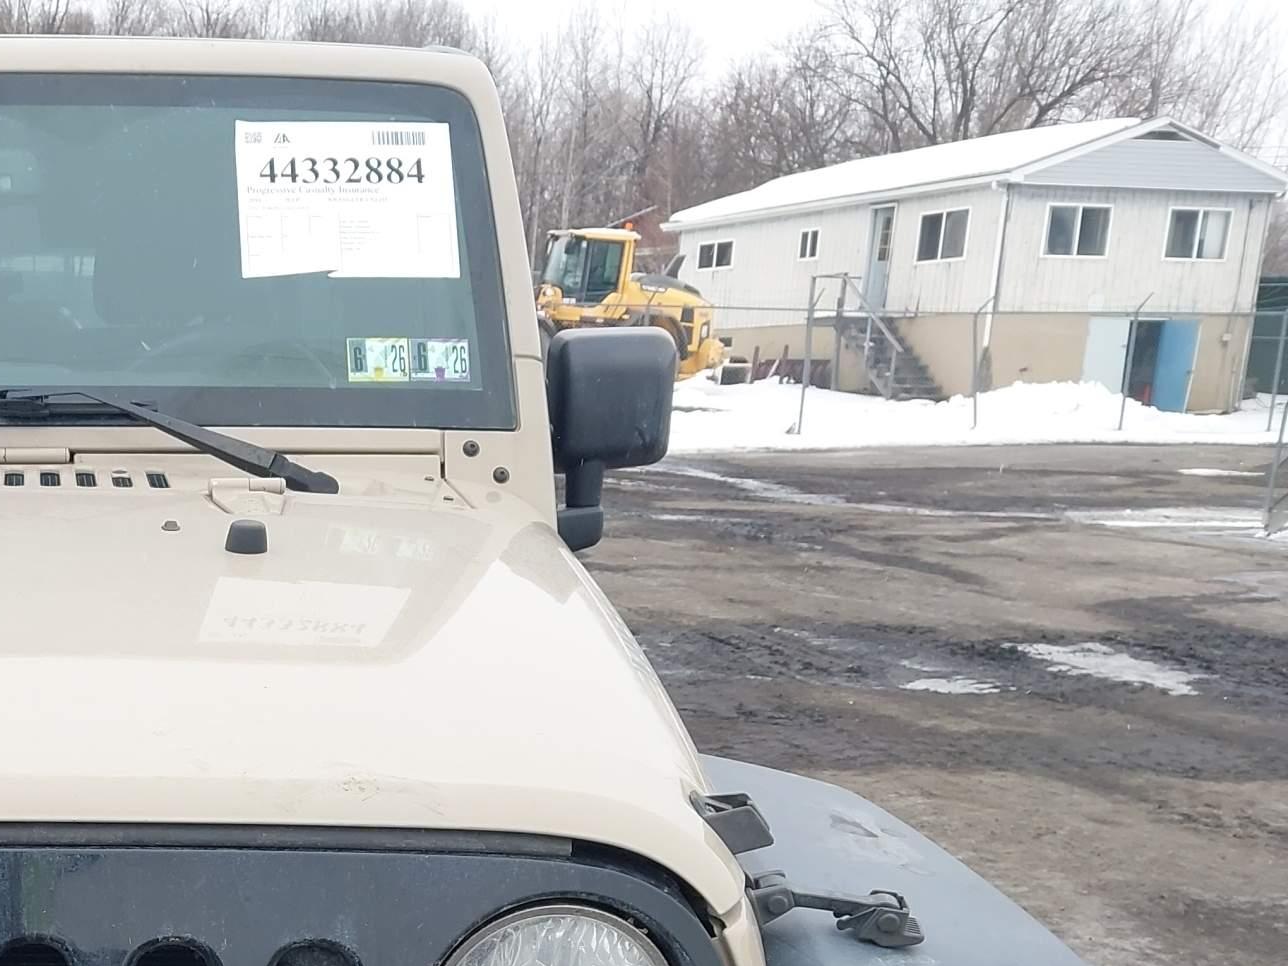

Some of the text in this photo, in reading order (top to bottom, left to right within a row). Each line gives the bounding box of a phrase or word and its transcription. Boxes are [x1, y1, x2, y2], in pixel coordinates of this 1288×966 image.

[259, 156, 425, 184] 44332884
[353, 344, 406, 373] 6 26
[417, 342, 468, 374] 6 26
